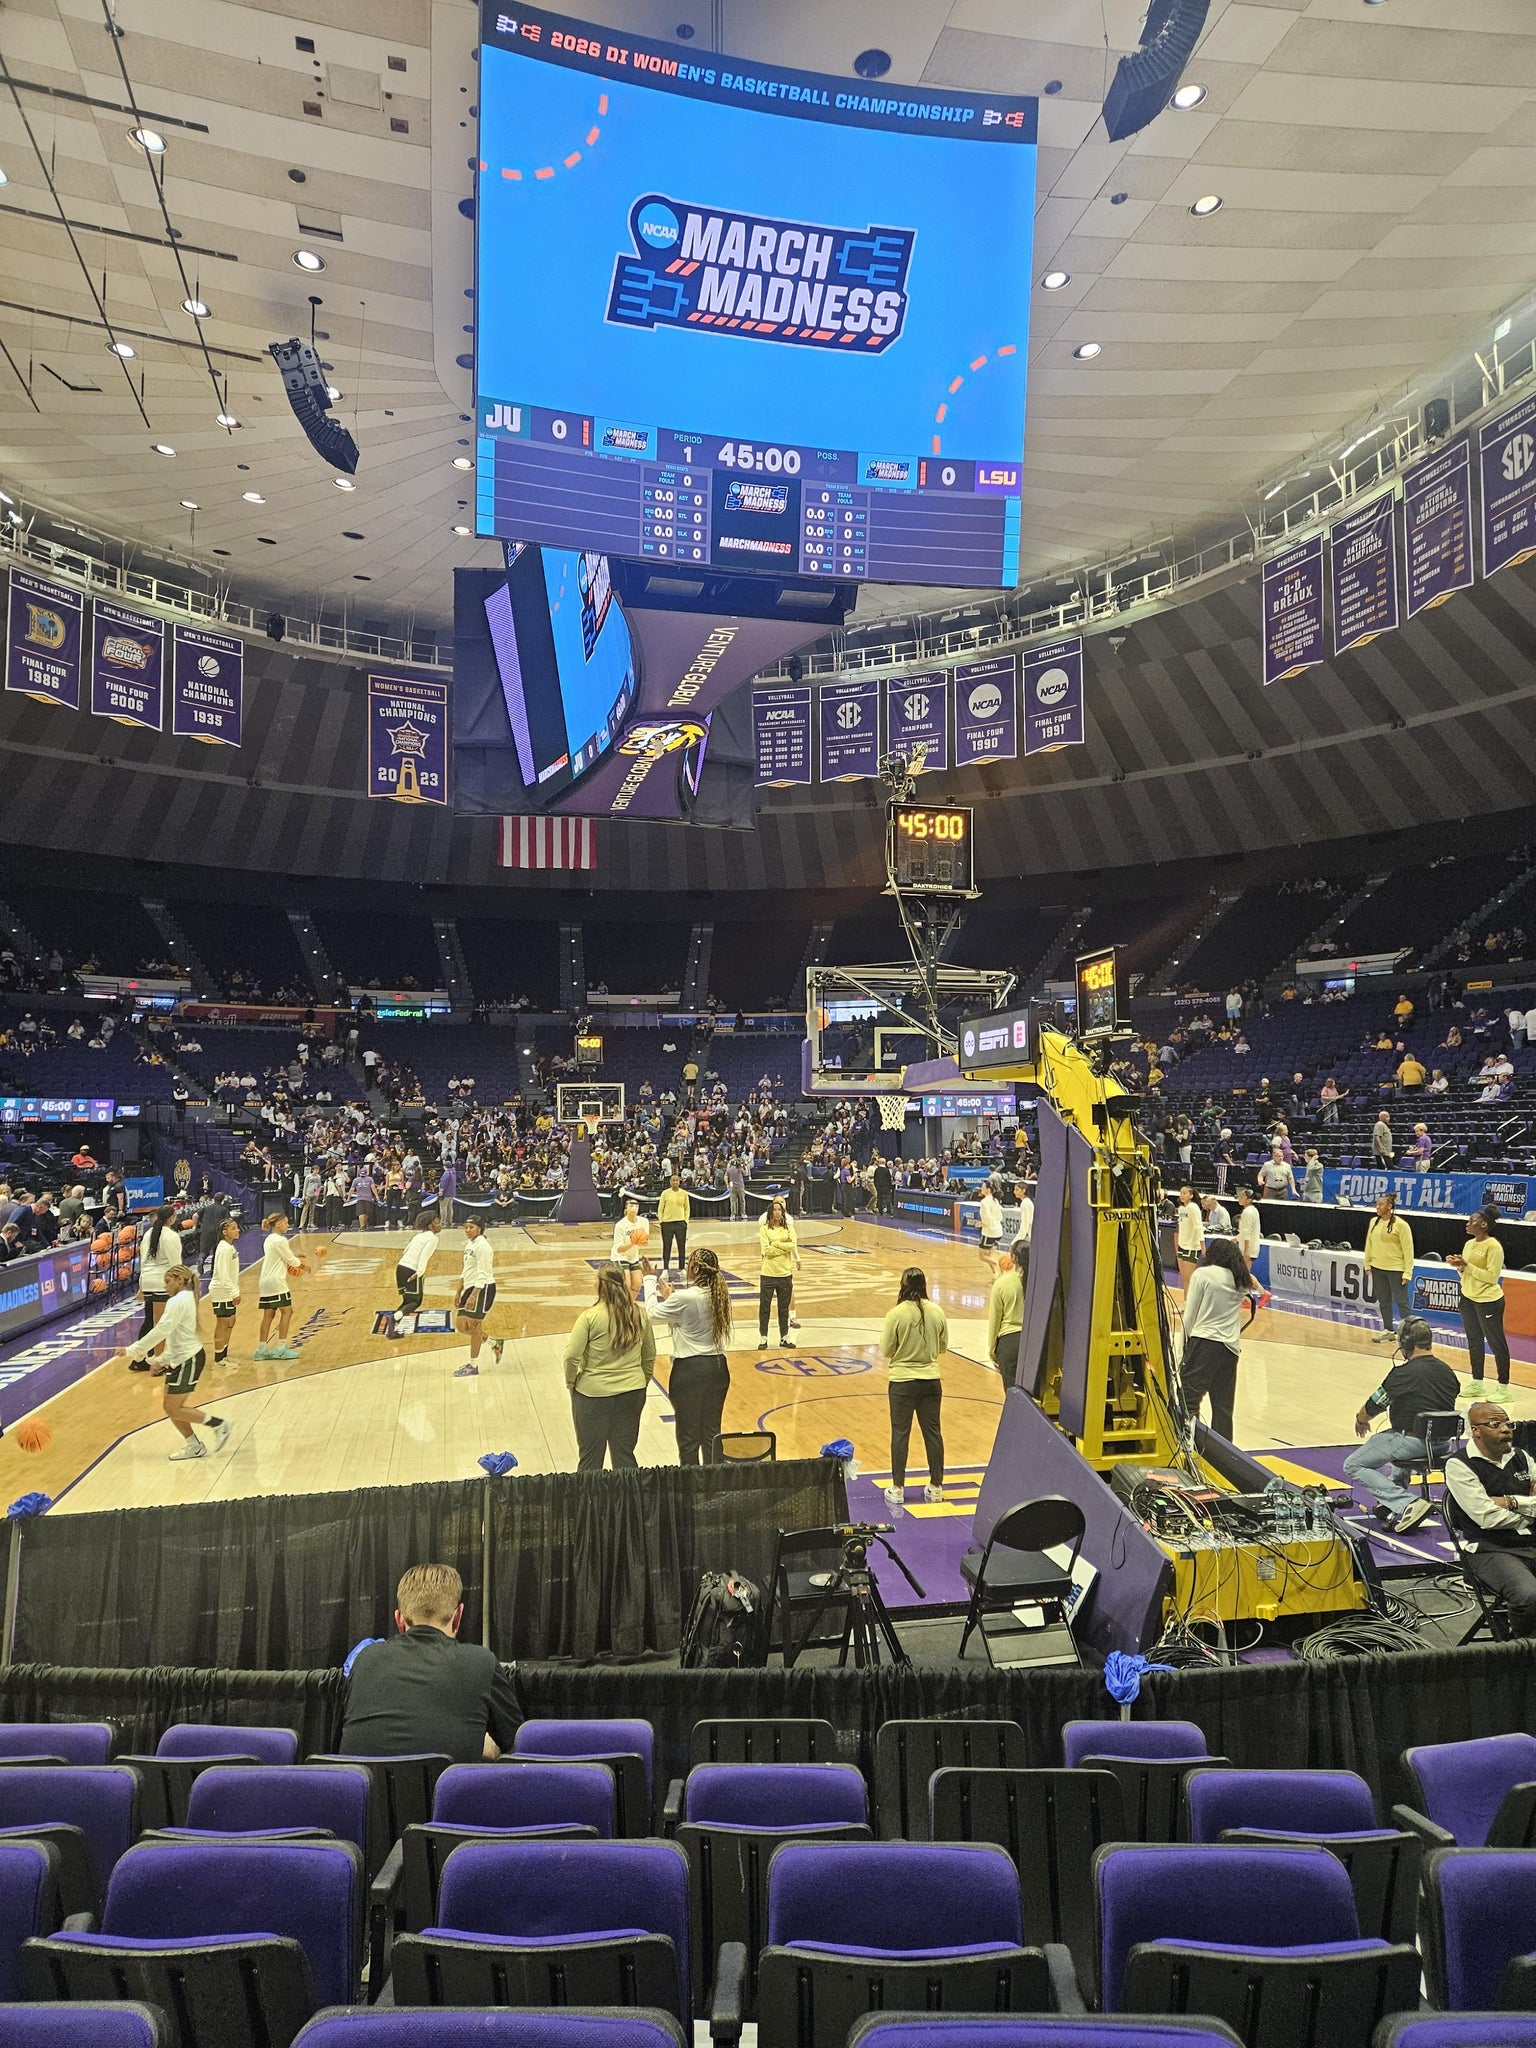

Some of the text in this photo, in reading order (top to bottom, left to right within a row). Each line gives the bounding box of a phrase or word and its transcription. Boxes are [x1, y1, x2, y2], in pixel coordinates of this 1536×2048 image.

[550, 31, 976, 124] 2026 DI WOMEN'S BASKETBALL CHAMPIONSHIP
[642, 222, 678, 240] NCAA
[680, 212, 834, 280] MARCH
[697, 266, 902, 336] MADNESS
[485, 403, 522, 433] JU
[1498, 402, 1536, 432] GYMNASTICS
[551, 419, 567, 439] 0
[615, 436, 648, 451] MADNESS
[673, 432, 703, 445] PERIOD
[682, 446, 692, 462] 1
[718, 442, 801, 474] 45:00
[816, 450, 840, 461] POSS.
[1501, 433, 1535, 481] SEC
[683, 475, 692, 486] 0
[941, 466, 956, 486] 0
[979, 469, 1017, 486] LSU
[1419, 459, 1452, 486] GYMNASTICS
[654, 489, 674, 502] 0.0
[740, 485, 771, 498] MARCH
[821, 492, 830, 503] 0
[1420, 486, 1453, 513] NATIONAL
[694, 494, 702, 506] 0
[743, 496, 786, 509] MADNESS
[1416, 492, 1458, 524] CHAMPIONS
[654, 507, 674, 520] 0.0
[693, 512, 702, 524] 0
[806, 508, 825, 520] 0.0
[844, 511, 853, 522] 0
[654, 525, 673, 538] 0.0
[693, 530, 702, 541] 0
[806, 525, 824, 537] 0.0
[844, 528, 852, 539] 0
[659, 544, 668, 554] 0
[719, 536, 792, 554] MARCHMADNESS
[805, 543, 824, 554] 0.0
[843, 546, 852, 556] 0
[1343, 538, 1382, 568] CHAMPIONS
[1346, 533, 1378, 557] NATIONAL
[692, 548, 701, 559] 0
[810, 560, 818, 570] 0
[842, 563, 852, 574] 0
[20, 576, 74, 602] MEN'S BASKETBALL
[1273, 584, 1313, 614] BREAUX
[116, 642, 142, 656] FINAL
[202, 634, 234, 649] BASKETBALL
[106, 646, 143, 663] FOUR
[21, 656, 67, 678] FINAL FOUR
[666, 626, 740, 707] VENTURE GLOBAL
[28, 668, 60, 690] 1986
[105, 681, 149, 700] FINAL FOUR
[187, 680, 229, 697] NATIONAL
[374, 682, 441, 697] WOMEN'S BASKETBALL
[1040, 682, 1068, 698] NCAA
[110, 693, 144, 712] 2006
[182, 688, 234, 707] CHAMPIONS
[972, 698, 1000, 711] NCAA
[390, 700, 426, 712] NATIONAL
[904, 693, 930, 721] SEC
[192, 710, 223, 727] 1935
[378, 708, 437, 724] CHAMPIONS
[766, 710, 795, 720] NCAA
[836, 702, 862, 729] SEC
[1035, 712, 1072, 728] FINAL FOUR
[901, 722, 933, 733] CHAMPIONS
[966, 728, 1004, 740] FINAL FOUR
[1042, 724, 1065, 739] 1991
[972, 738, 998, 752] 1990
[378, 766, 439, 786] 20 23
[610, 756, 657, 811] VENTURE GLOBAL
[899, 813, 964, 840] 45:00
[1085, 1024, 1113, 1036] DAKTRONICS
[978, 1027, 1009, 1052] ESPN
[41, 1101, 72, 1111] 45:00
[956, 1098, 982, 1107] 45:00
[1394, 1177, 1417, 1206] IT
[1418, 1178, 1455, 1208] ALL
[1490, 1183, 1514, 1193] MARCH
[1494, 1192, 1526, 1203] MADNESS
[1104, 1211, 1146, 1222] SPALDING
[1277, 1264, 1308, 1280] HOSTED
[1310, 1269, 1323, 1282] BY
[40, 1278, 55, 1296] LSU
[60, 1271, 68, 1292] 0
[1424, 1279, 1459, 1294] MARCH
[0, 1282, 39, 1314] MADNESS
[1429, 1293, 1462, 1308] MADN
